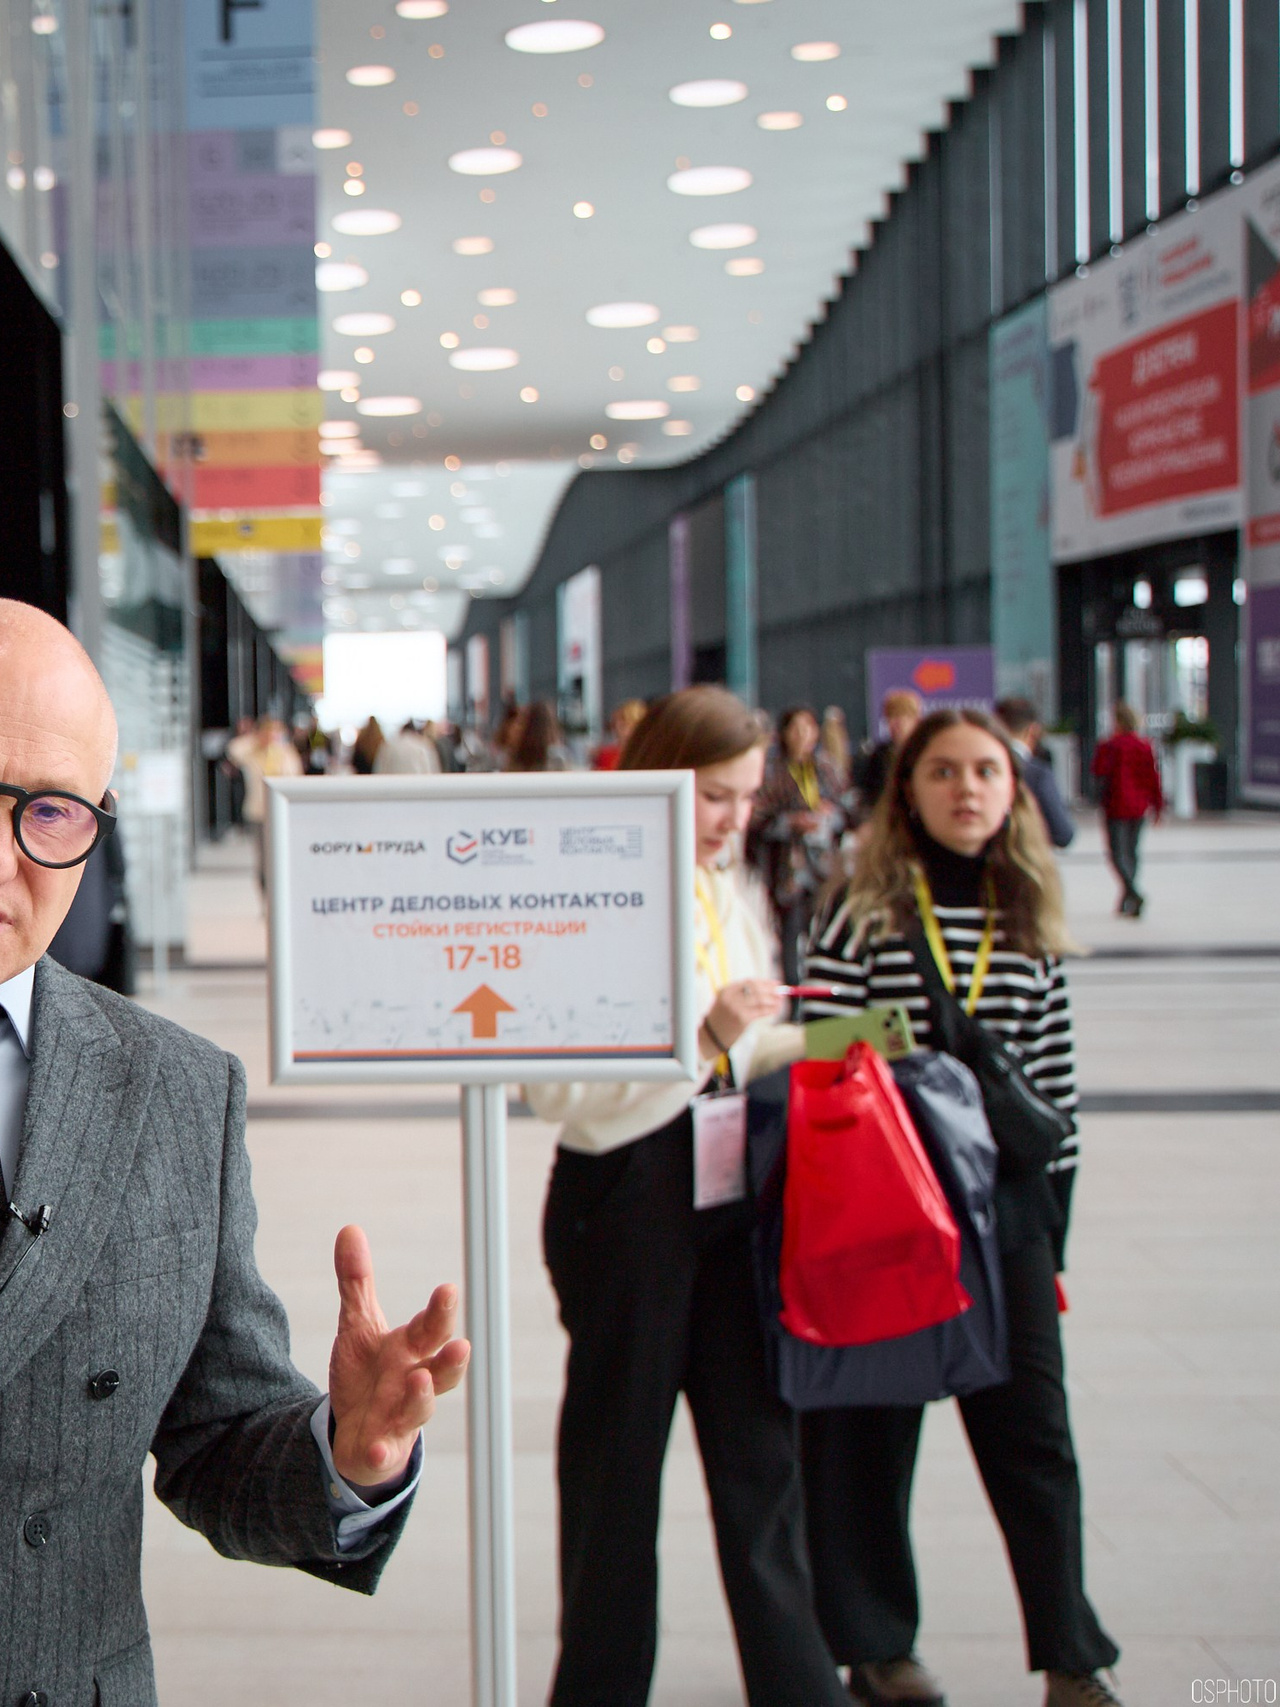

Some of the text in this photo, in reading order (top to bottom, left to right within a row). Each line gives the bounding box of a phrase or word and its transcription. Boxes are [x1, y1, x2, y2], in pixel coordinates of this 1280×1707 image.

[482, 828, 527, 846] КУБ
[376, 840, 425, 854] ТРУДА
[312, 892, 643, 914] ЦЕНТР ДЕЛОВЫХ КОНТАКТОВ
[373, 920, 587, 938] СТОЙКИ РЕГИСТРАЦИИ
[444, 945, 521, 970] 17-18
